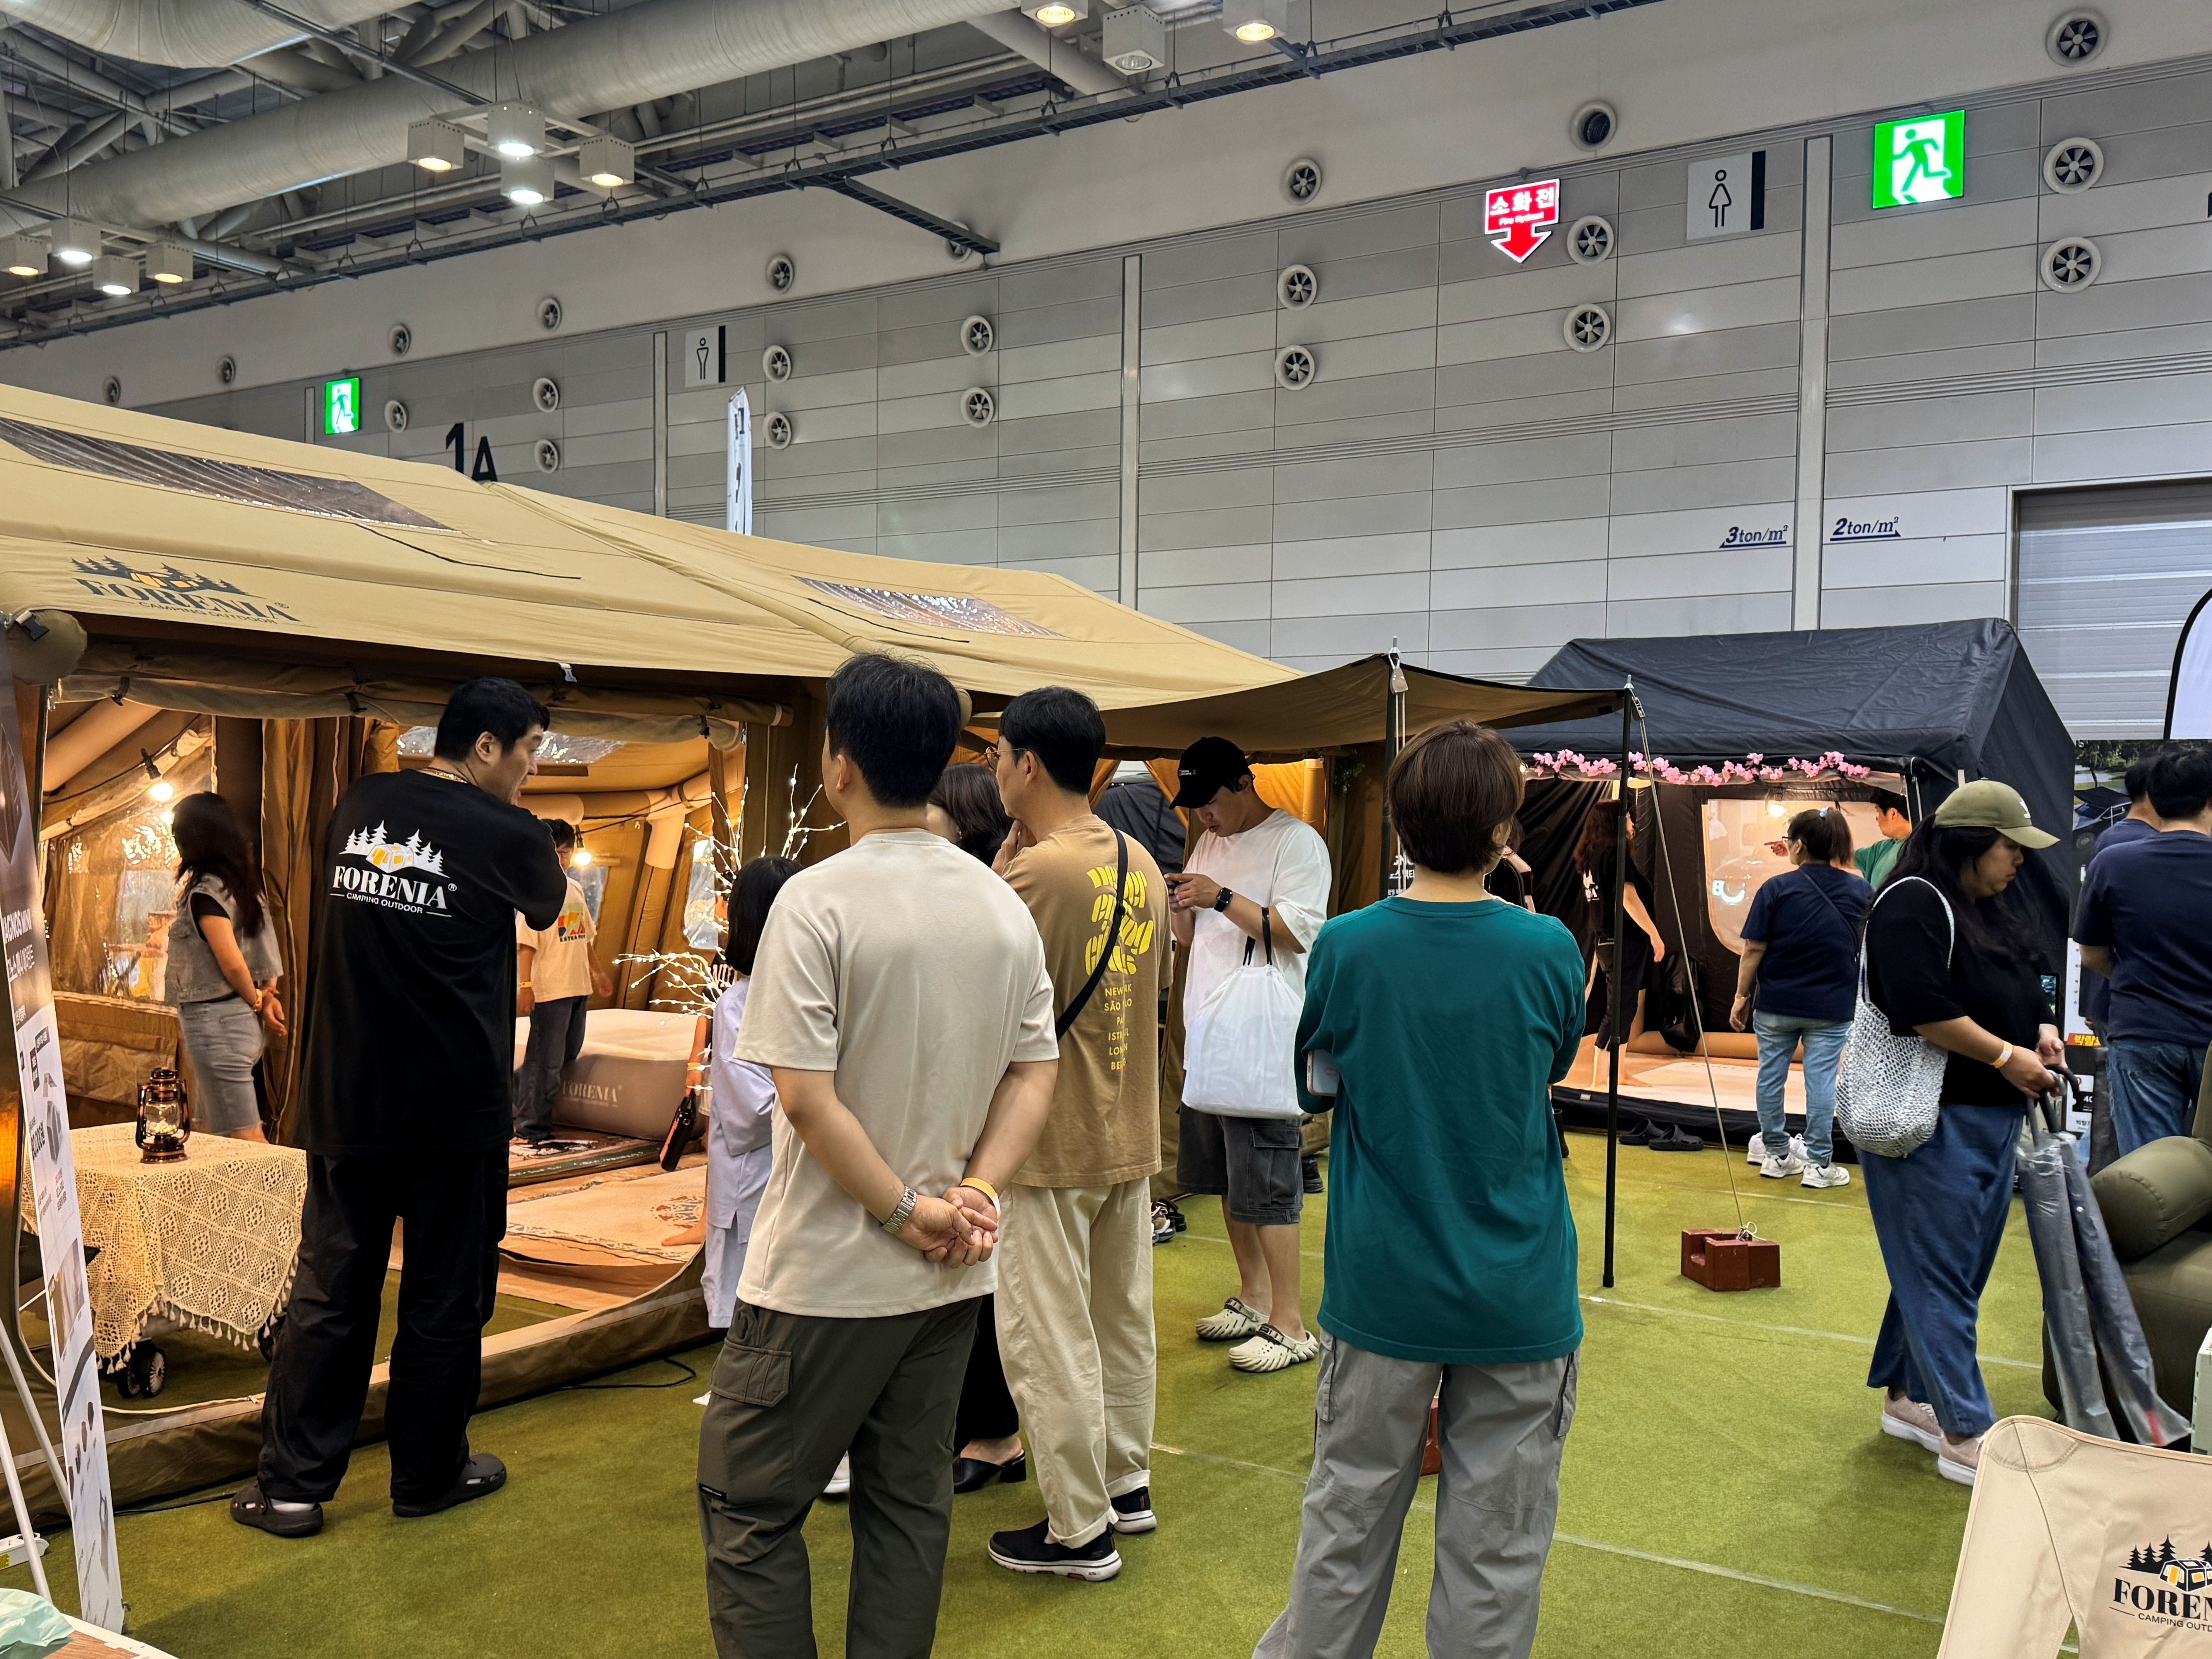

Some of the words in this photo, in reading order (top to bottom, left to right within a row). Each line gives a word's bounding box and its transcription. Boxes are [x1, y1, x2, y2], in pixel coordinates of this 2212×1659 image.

[1489, 186, 1554, 215] 소화전
[74, 578, 301, 622] FORENIA
[139, 601, 208, 615] CAMPING
[208, 611, 277, 624] OUTDOOR
[333, 866, 447, 909] FORENIA
[346, 892, 379, 904] CAMPING
[381, 899, 423, 914] OUTDOOR
[2138, 1613, 2183, 1627] CAMPING
